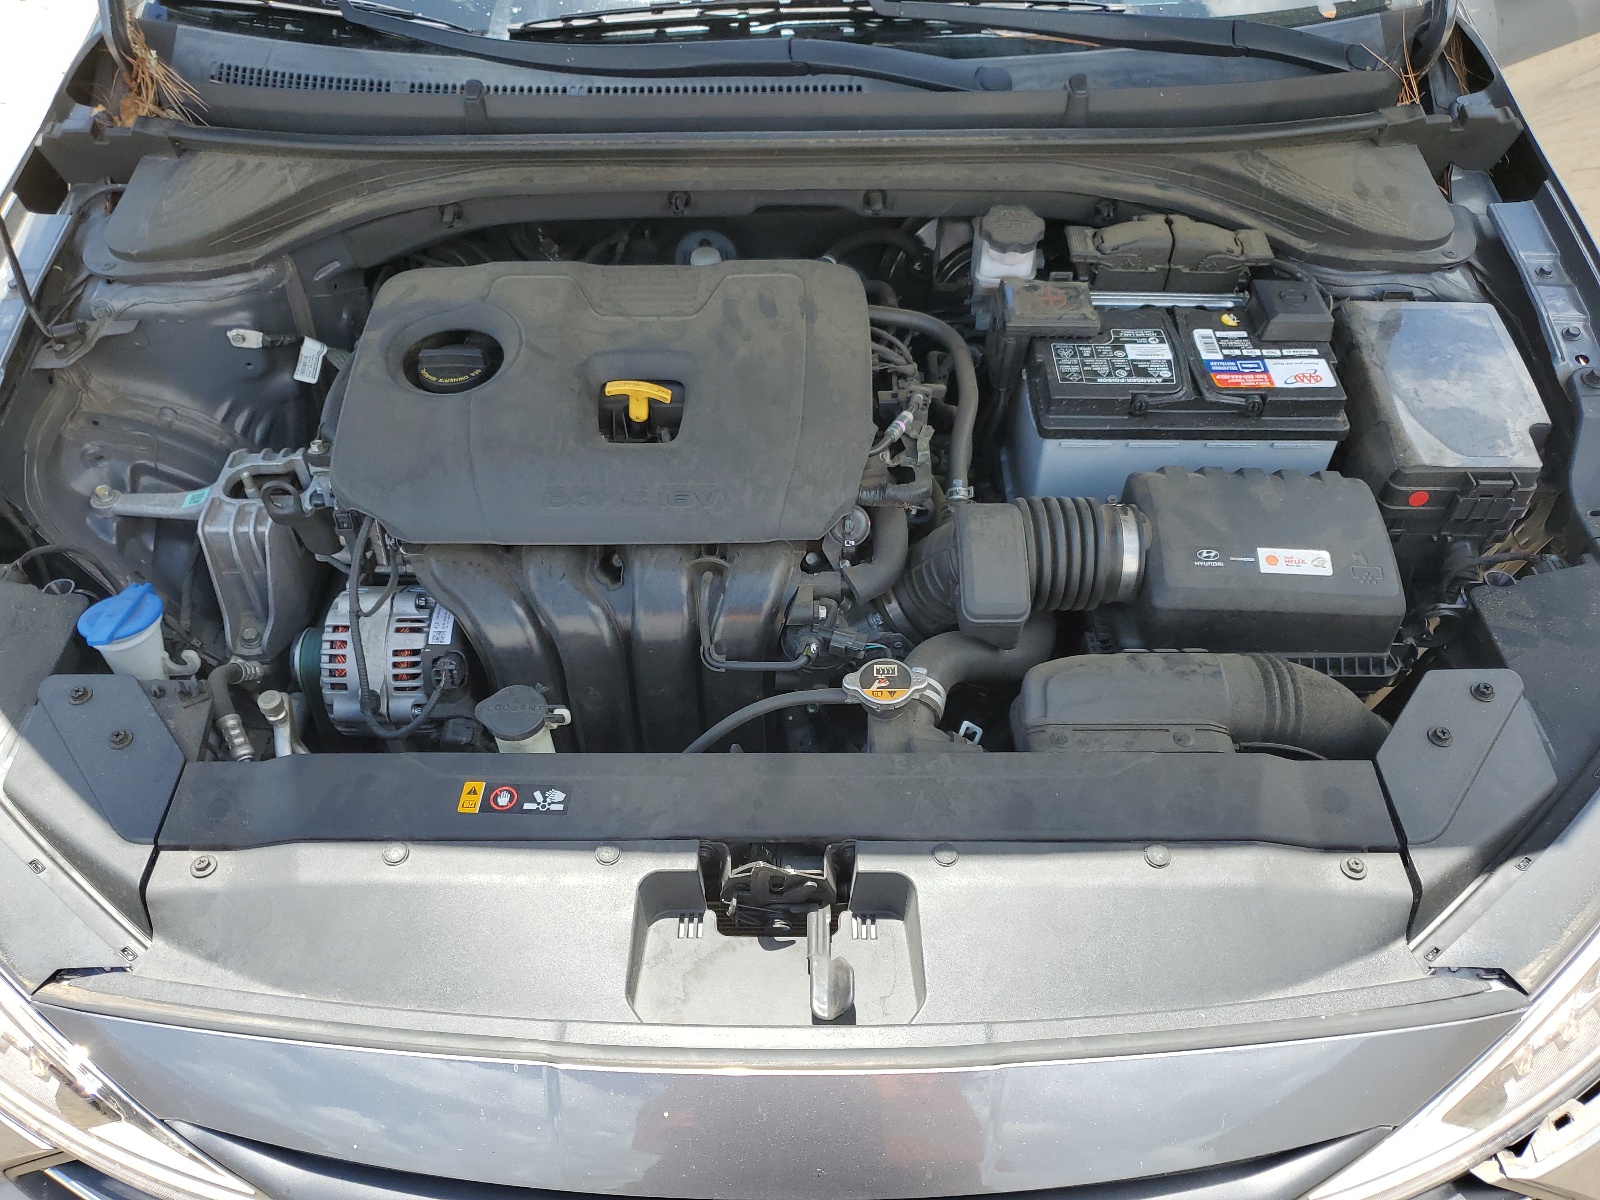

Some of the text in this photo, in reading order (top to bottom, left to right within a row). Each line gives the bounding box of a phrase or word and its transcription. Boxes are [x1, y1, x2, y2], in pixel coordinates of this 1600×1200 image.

[438, 374, 469, 383] OWNER'S
[1295, 373, 1322, 384] AAA
[486, 703, 544, 713] COOLANT
